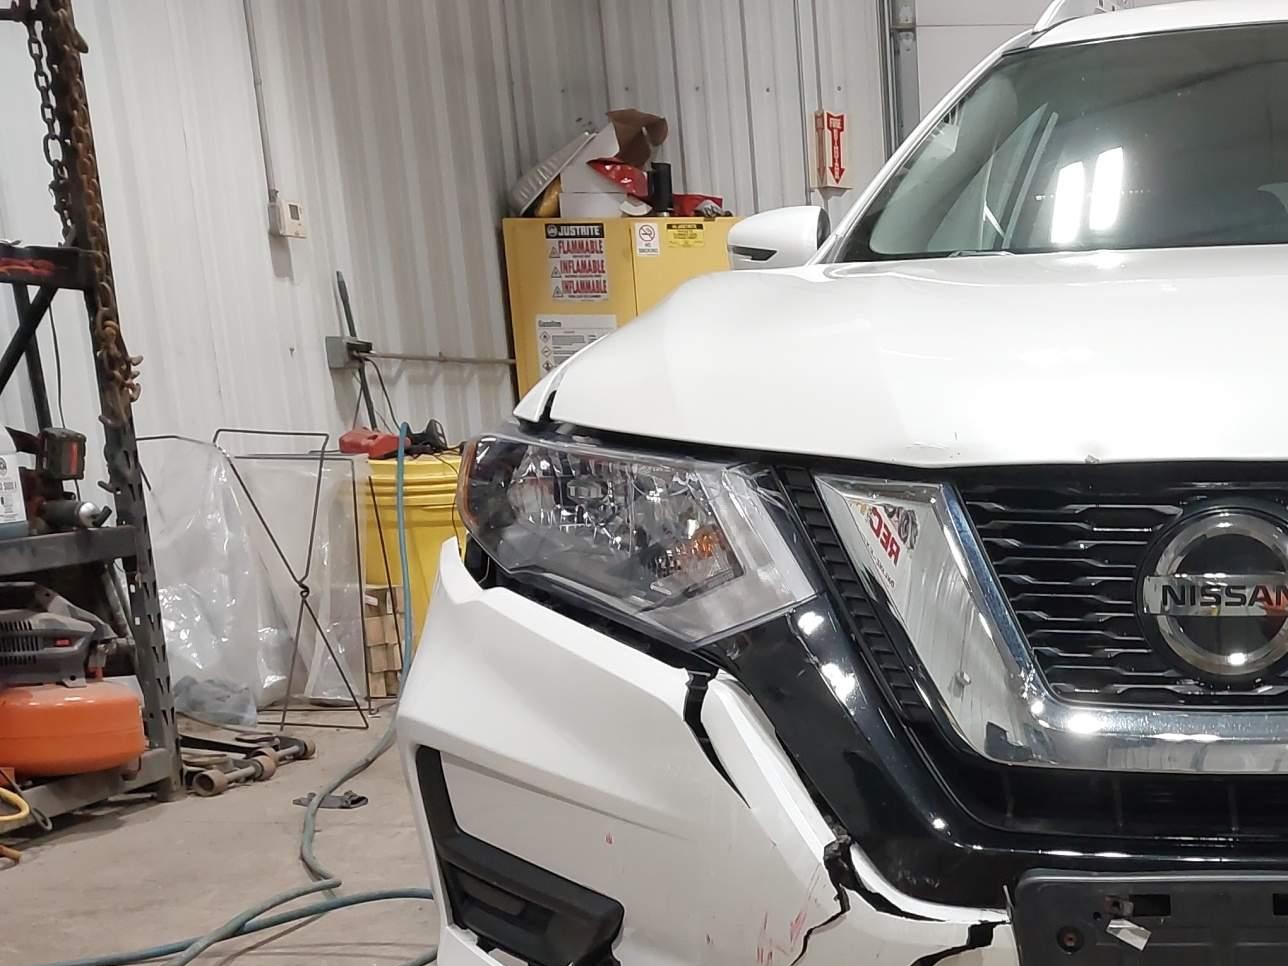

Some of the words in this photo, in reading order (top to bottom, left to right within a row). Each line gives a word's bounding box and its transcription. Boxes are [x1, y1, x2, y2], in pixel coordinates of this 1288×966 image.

[559, 225, 600, 236] JUSTRITE
[558, 240, 603, 254] FLAMMABLE
[560, 260, 605, 273] INFLAMABLE
[562, 280, 607, 294] INFLAMMABLE
